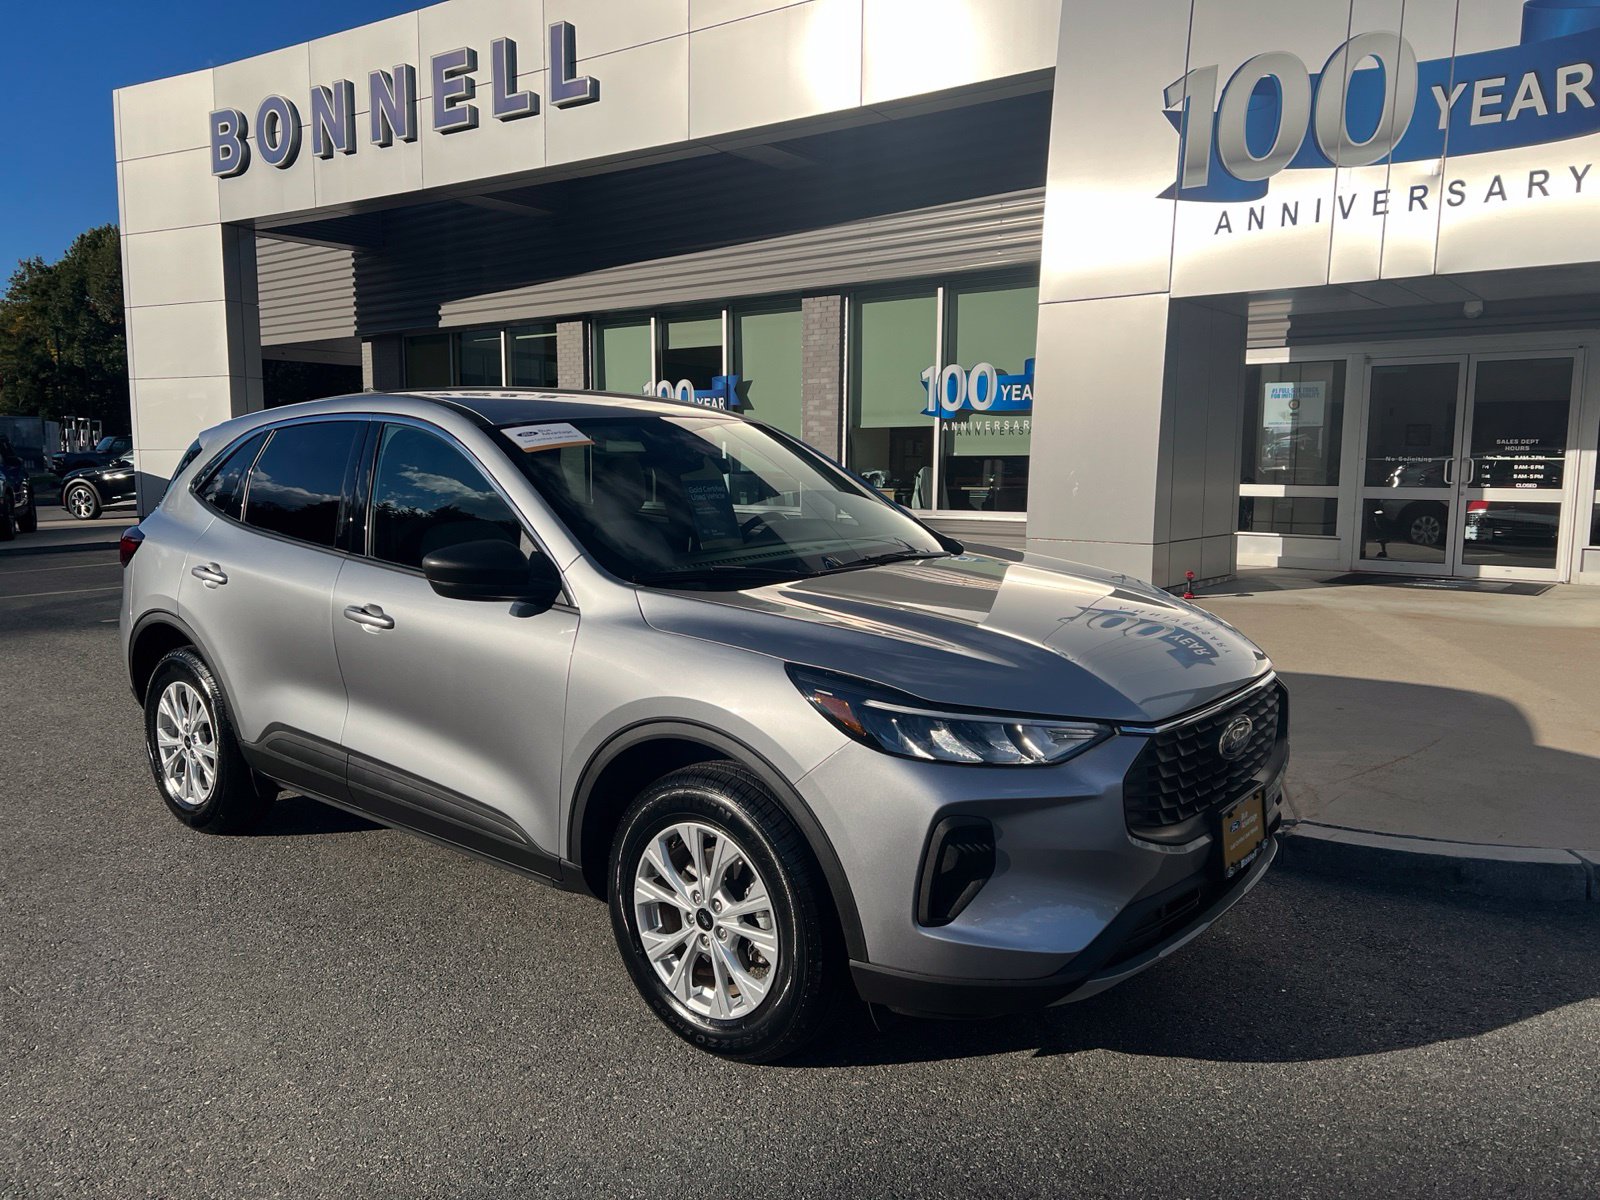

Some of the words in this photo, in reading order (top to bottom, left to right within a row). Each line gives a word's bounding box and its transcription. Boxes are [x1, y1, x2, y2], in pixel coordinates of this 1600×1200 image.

[209, 20, 600, 179] BONNELL
[1163, 30, 1418, 189] 100
[1431, 62, 1596, 131] YEAR
[1214, 163, 1593, 235] ANNIVERSARY
[920, 362, 998, 412] 100
[1398, 455, 1432, 463] Soliciting
